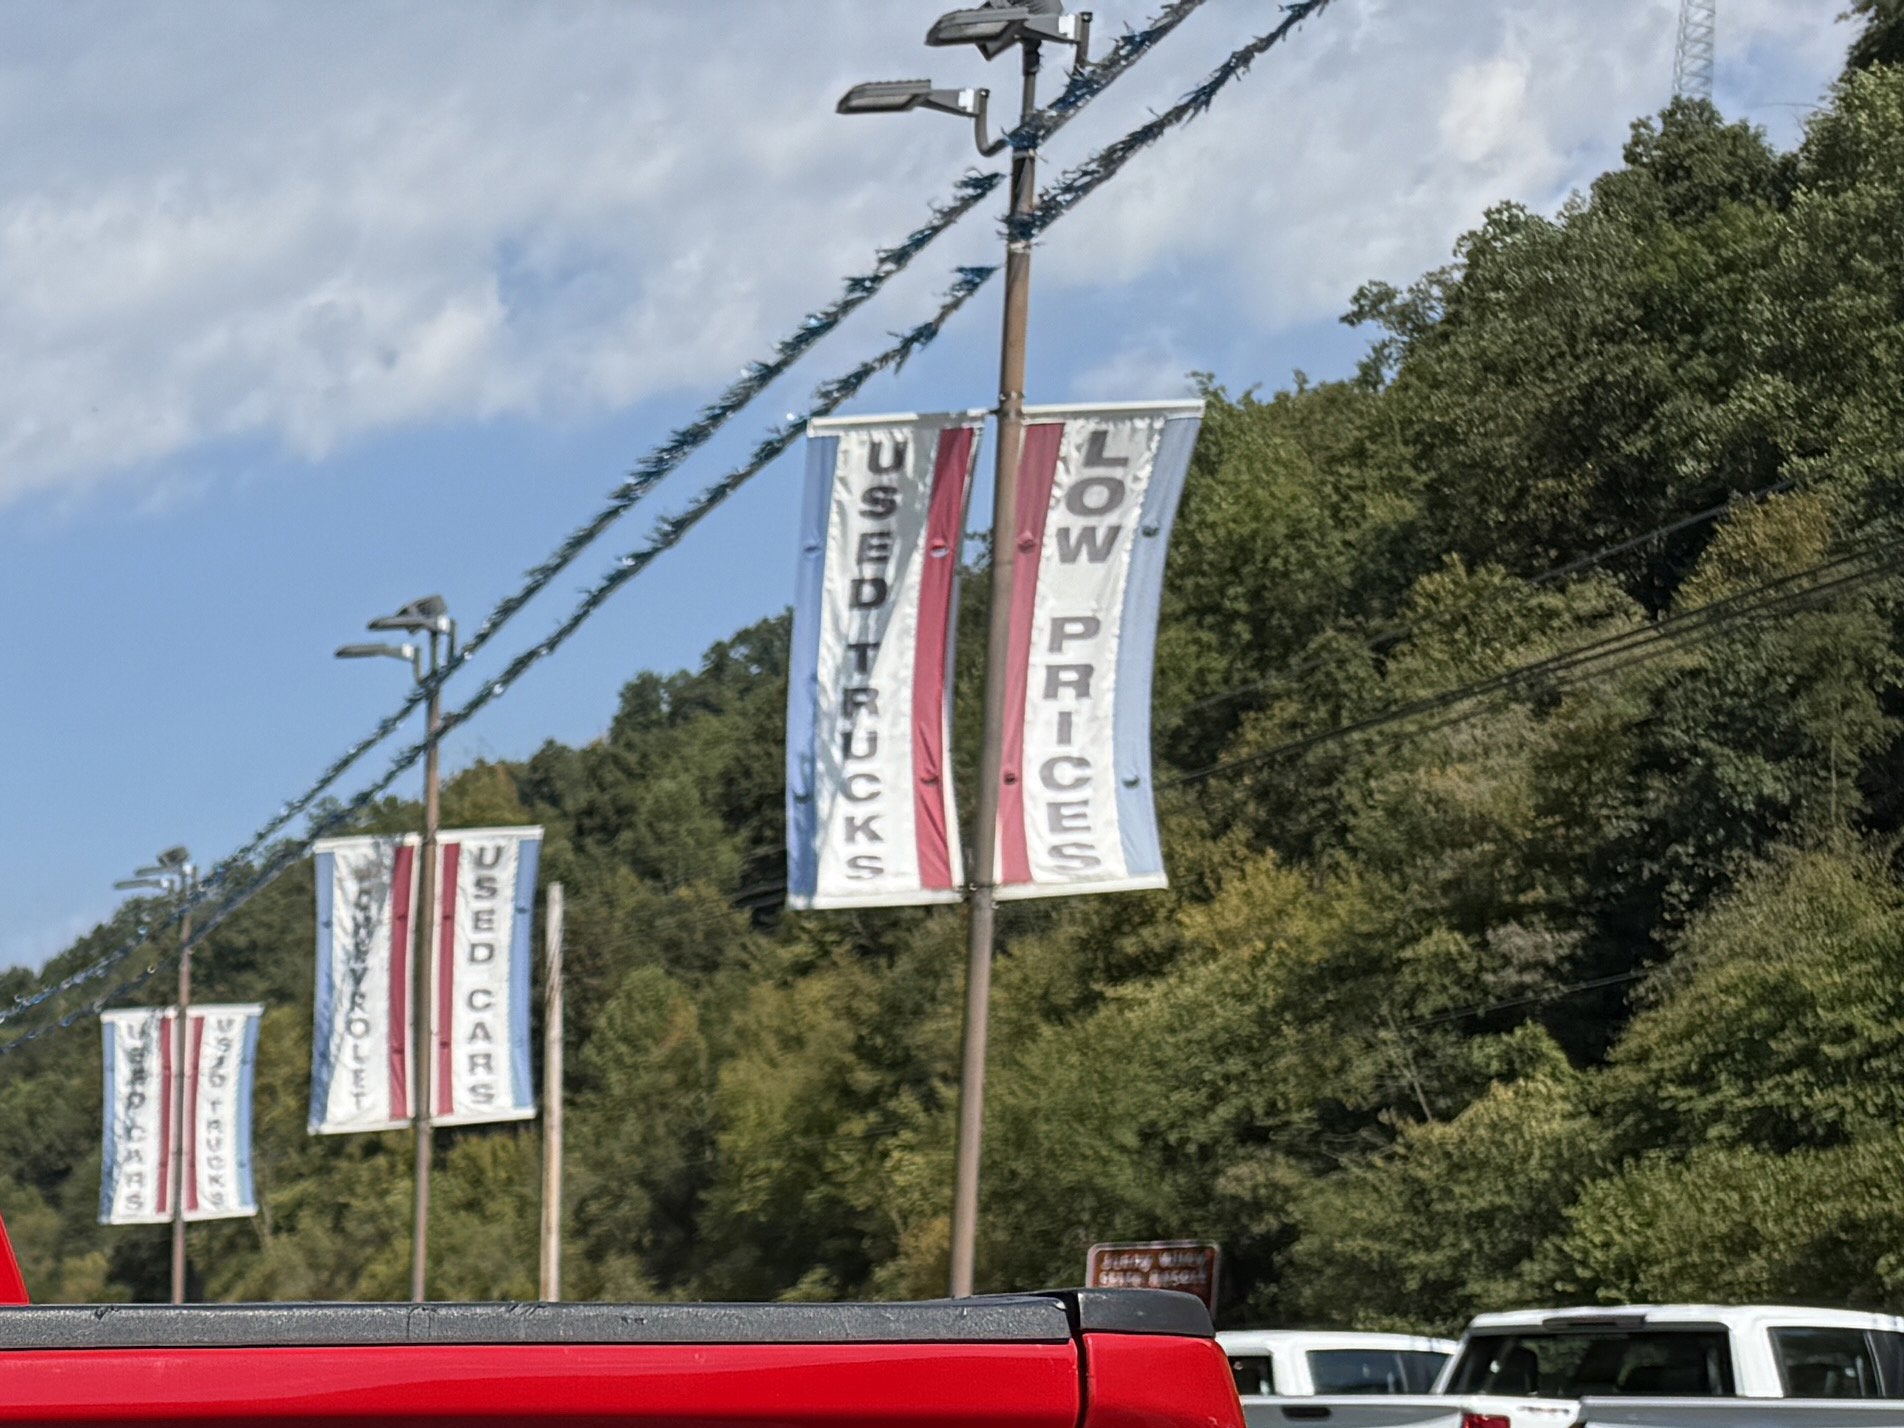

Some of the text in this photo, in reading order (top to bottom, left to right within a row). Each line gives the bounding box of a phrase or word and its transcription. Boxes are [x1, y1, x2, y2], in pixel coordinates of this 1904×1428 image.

[841, 439, 907, 882] USED TRUCKS
[1038, 429, 1130, 872] LOW PRICES
[467, 845, 504, 1104] USED CARS
